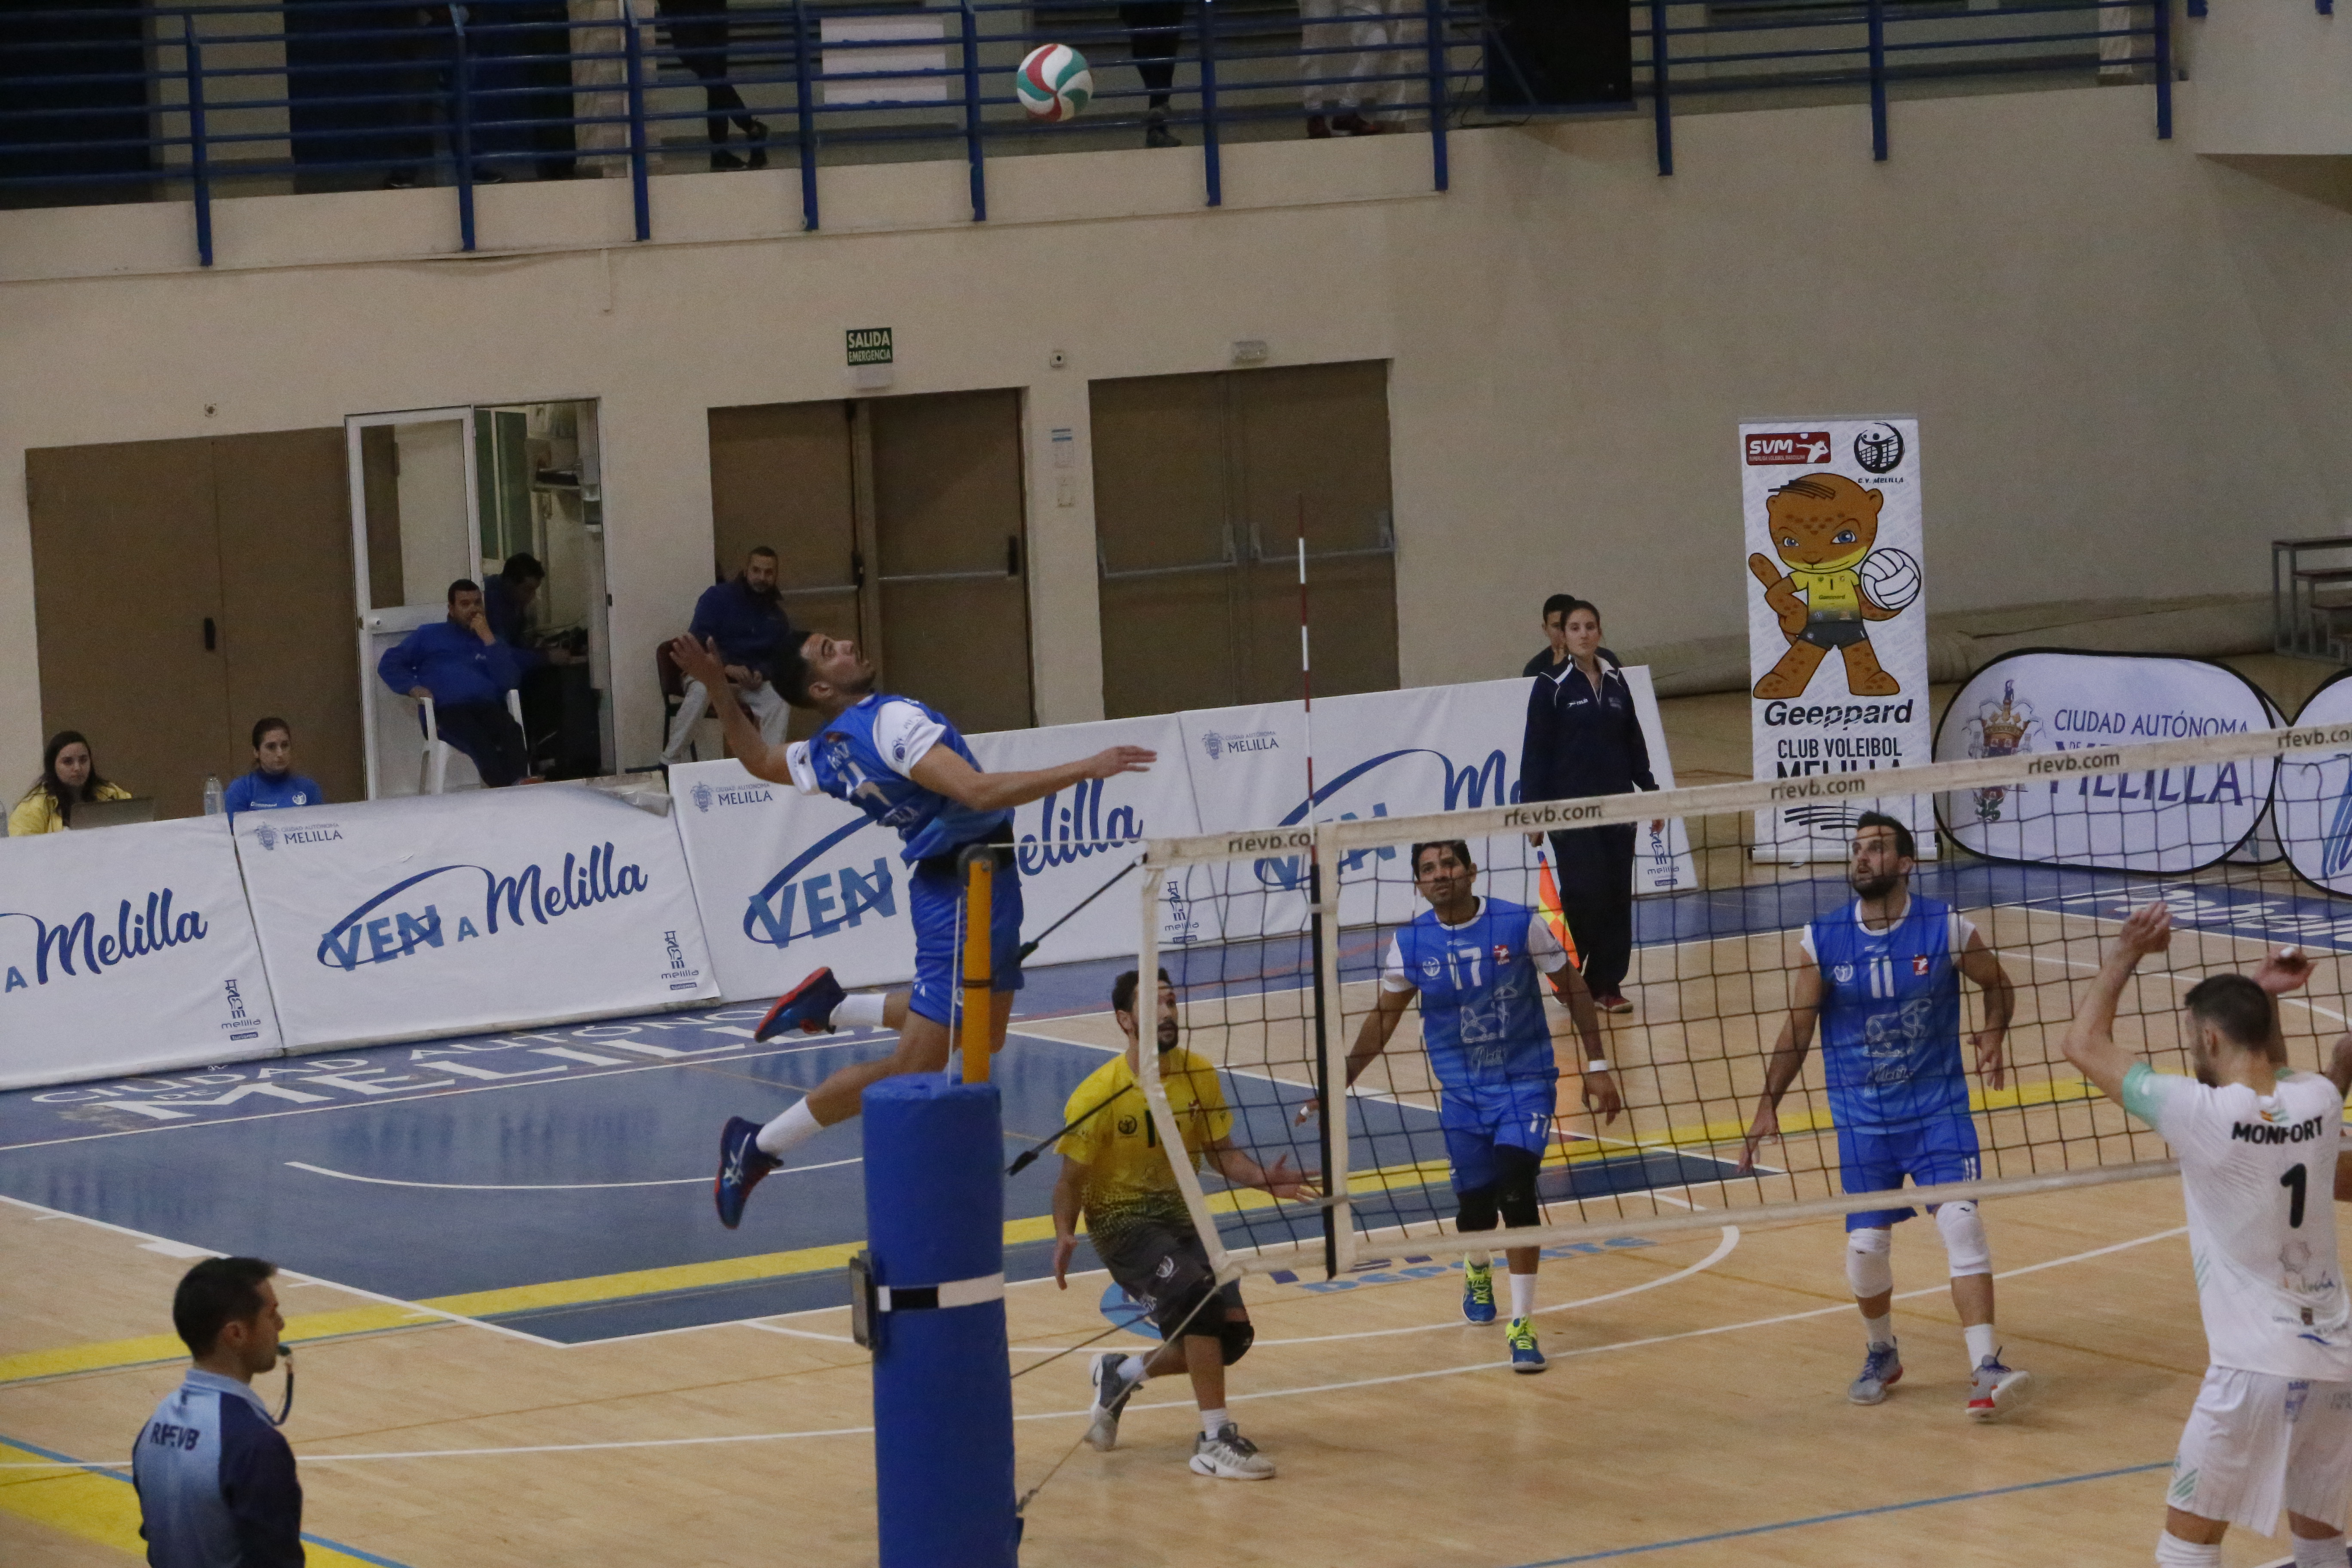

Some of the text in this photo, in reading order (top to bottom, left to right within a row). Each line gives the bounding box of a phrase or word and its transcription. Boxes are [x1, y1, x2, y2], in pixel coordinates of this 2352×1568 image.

[848, 331, 890, 348] SALIDA
[848, 349, 891, 362] EMERGENCIA
[1749, 439, 1793, 454] SVM
[1764, 699, 1913, 731] Geeppard
[2055, 709, 2125, 734] CIUDAD
[1228, 738, 1279, 753] MELILLA
[1778, 737, 1902, 759] CLUB VOLEIBOL
[2278, 727, 2352, 749] rfevb.co
[717, 790, 773, 805] MELILLA
[1504, 805, 1602, 827] rfevb.com
[284, 830, 343, 845] MELILLA
[1228, 833, 1318, 854] rfevb.co
[320, 841, 648, 972] VEN A Melilla
[748, 857, 897, 949] VEN
[5, 888, 208, 993] A Melilla
[661, 970, 699, 980] melilla
[1447, 947, 1482, 990] 17
[1870, 956, 1894, 998] 11
[221, 1019, 261, 1029] melilla
[31, 1058, 369, 1103] CIUDAD
[152, 1089, 220, 1100] DE
[2232, 1115, 2323, 1145] MONFORT
[2280, 1163, 2306, 1228] 1
